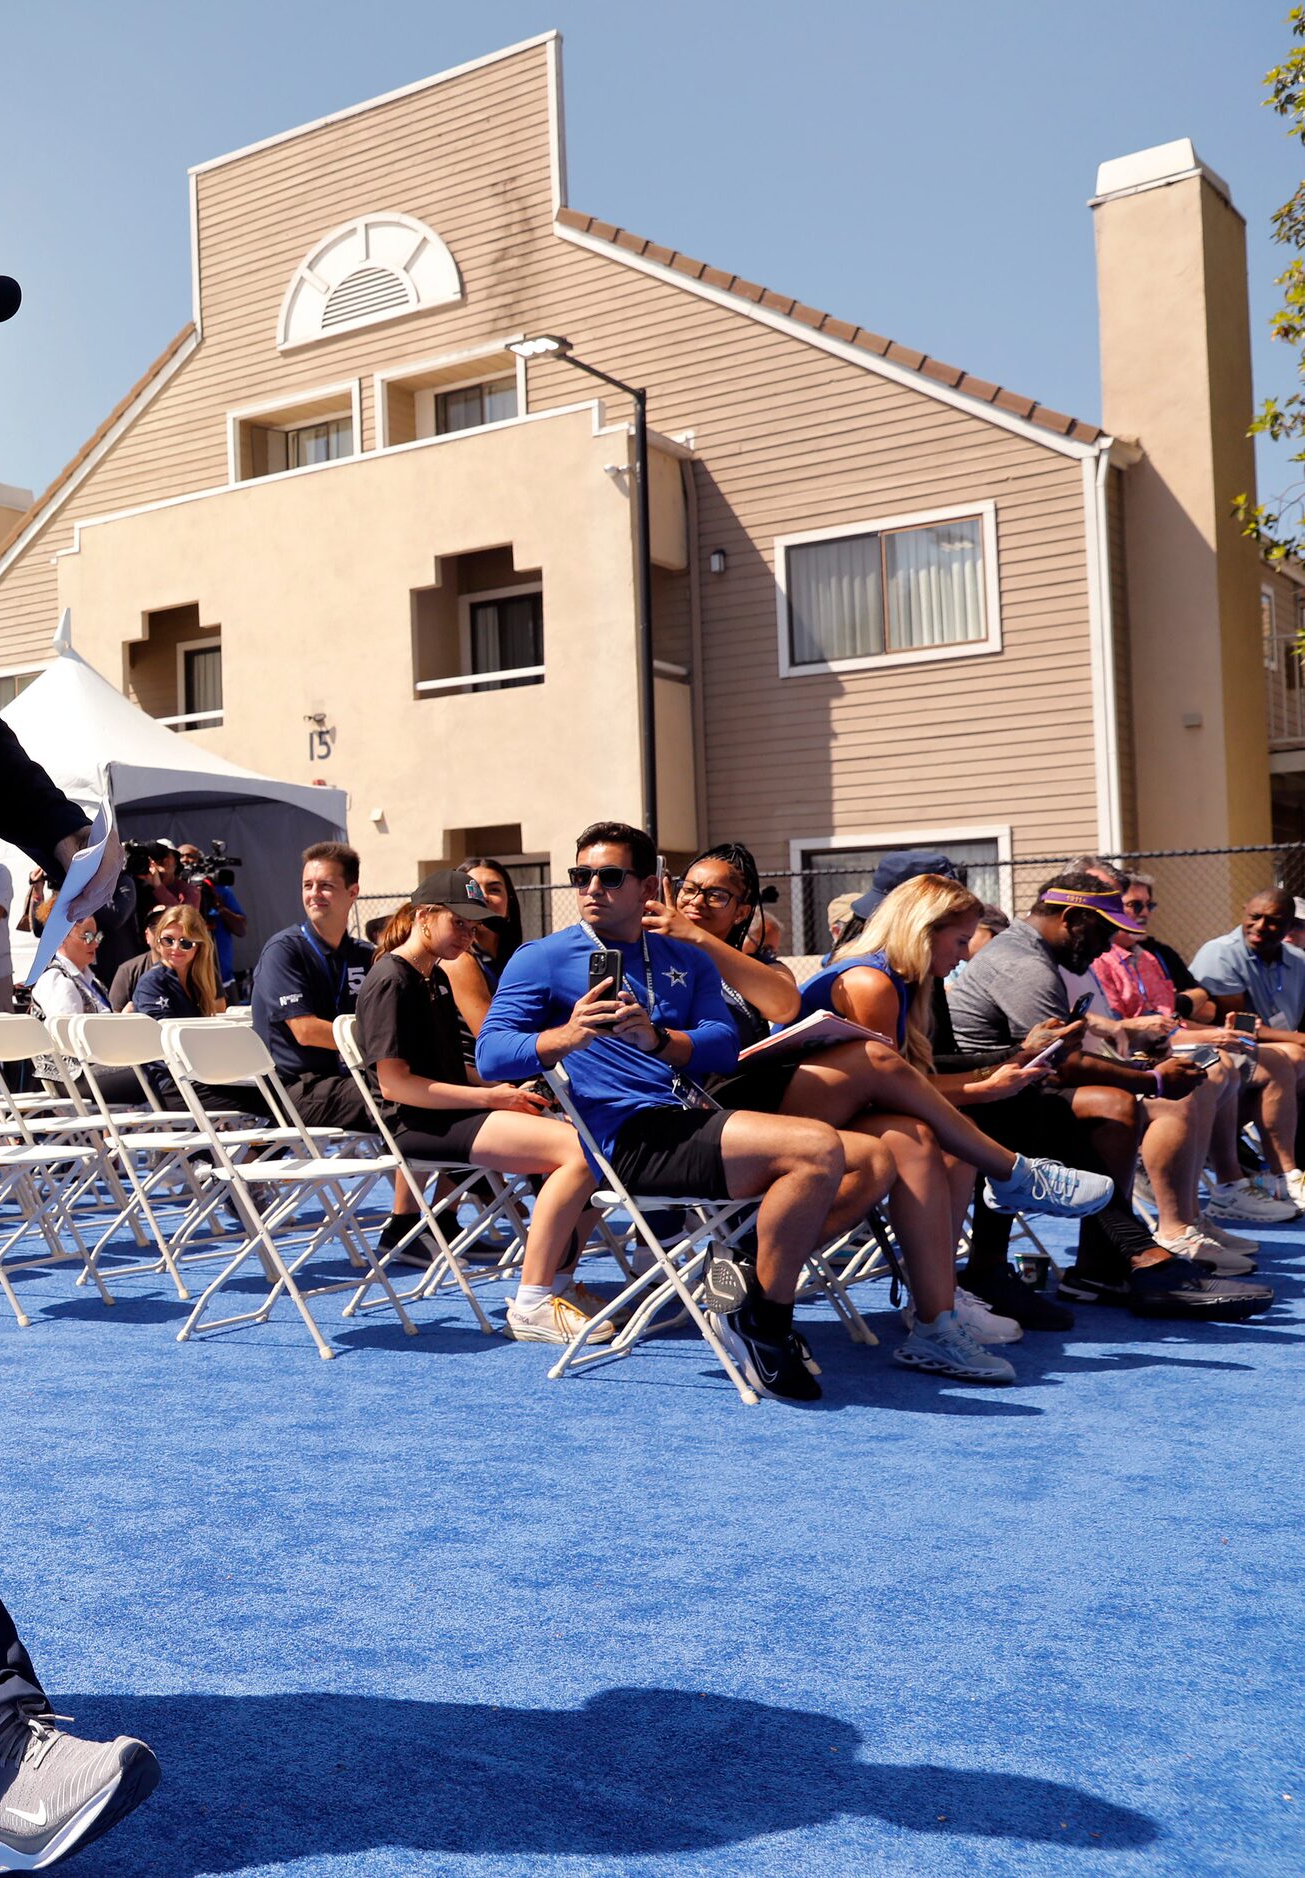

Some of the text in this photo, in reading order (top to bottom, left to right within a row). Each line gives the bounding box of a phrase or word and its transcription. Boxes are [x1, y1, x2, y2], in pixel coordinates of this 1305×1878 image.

[309, 731, 331, 761] 15
[347, 967, 367, 994] 5
[511, 1311, 530, 1325] HOKA
